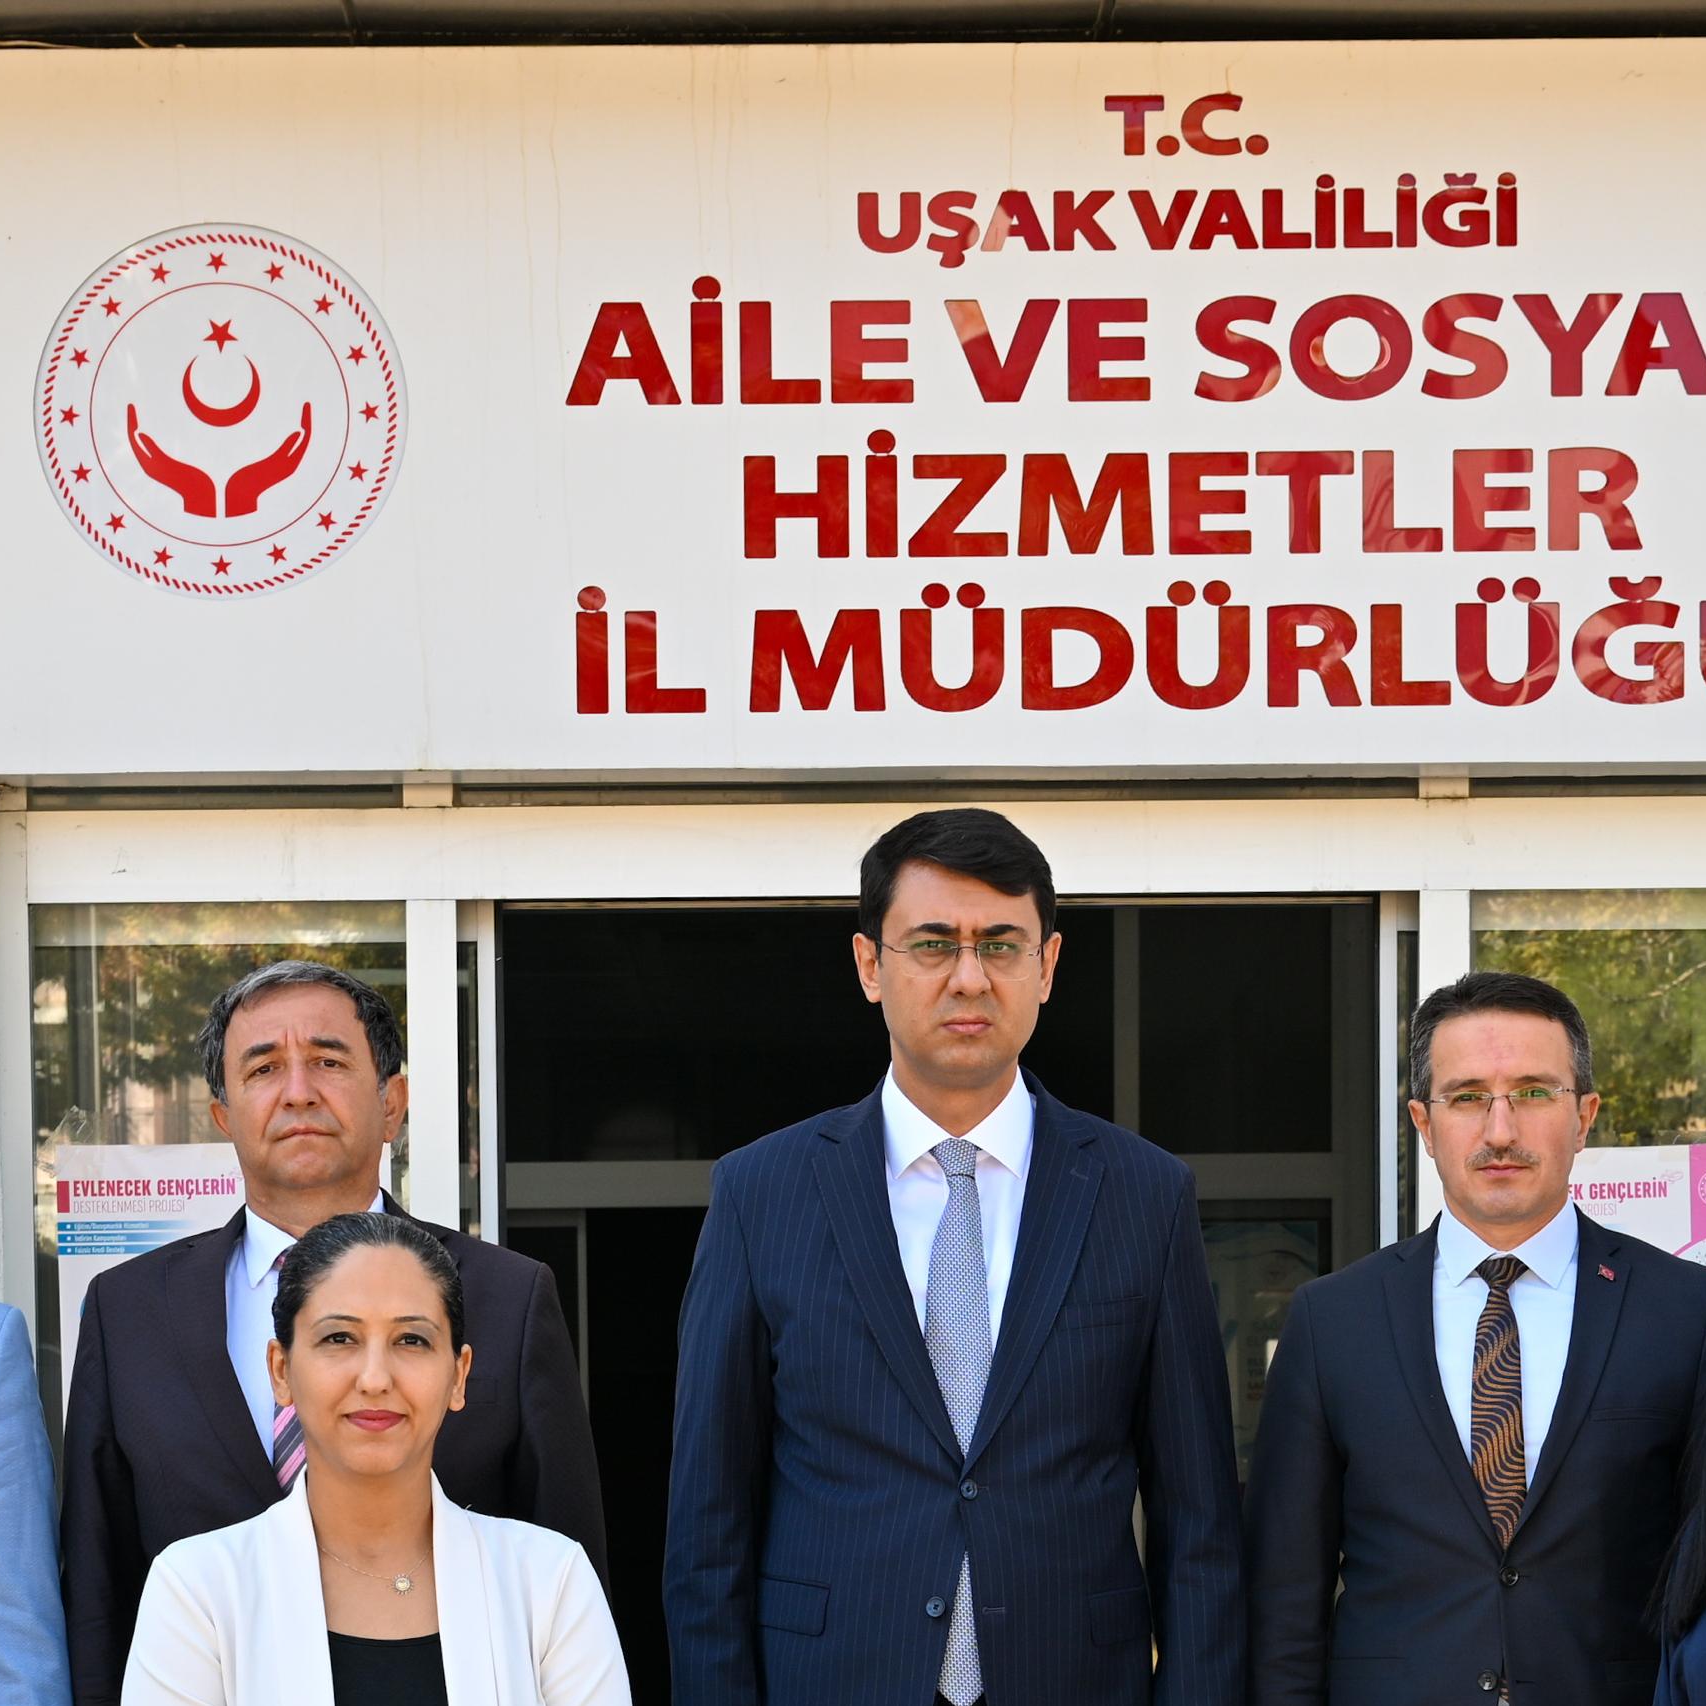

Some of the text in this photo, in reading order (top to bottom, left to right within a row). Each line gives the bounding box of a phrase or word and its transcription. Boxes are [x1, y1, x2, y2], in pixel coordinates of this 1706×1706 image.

[1104, 93, 1269, 158] T.C.
[856, 171, 1519, 269] UŞAK VALİLİĞİ
[564, 275, 915, 407] AİLE
[944, 298, 1152, 404] VE
[743, 429, 1644, 560] HİZMETLER
[576, 586, 708, 715] İL
[73, 1174, 236, 1199] EVLENECEK GENÇLERİN
[1589, 1177, 1668, 1203] GENÇLERİN
